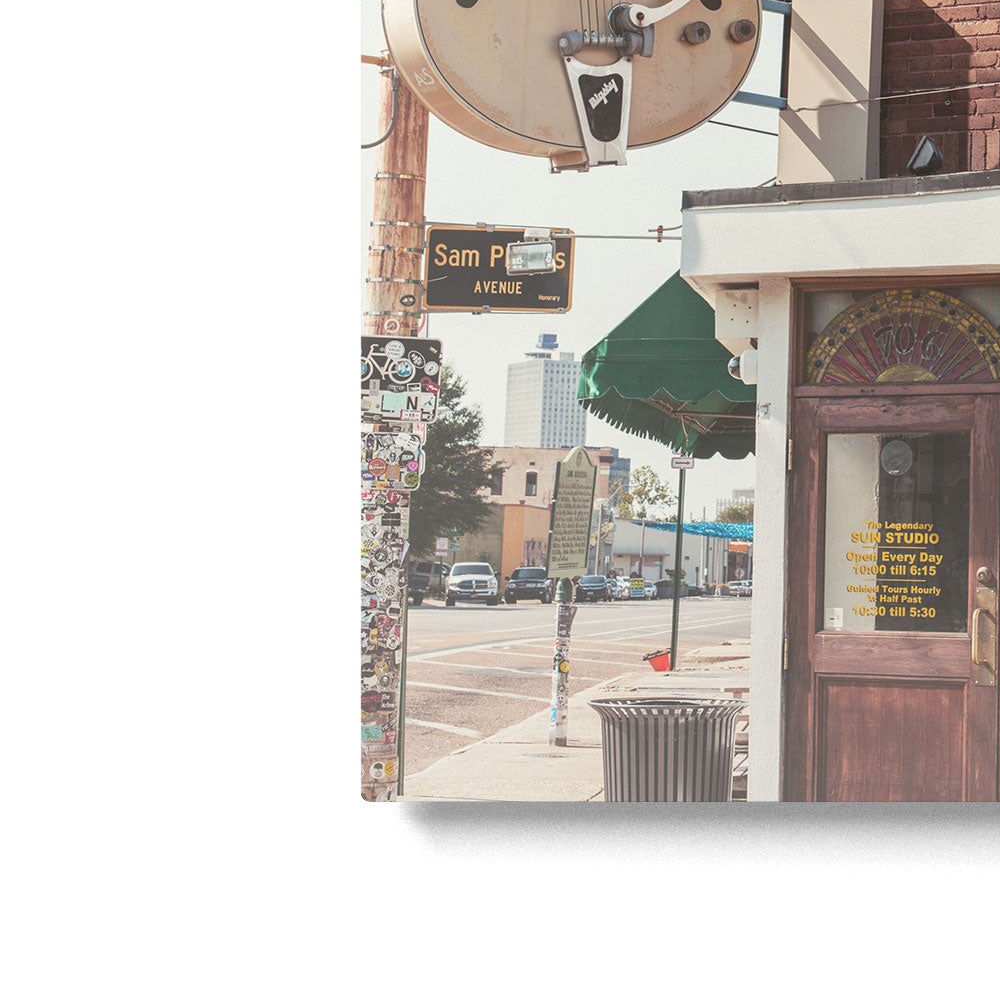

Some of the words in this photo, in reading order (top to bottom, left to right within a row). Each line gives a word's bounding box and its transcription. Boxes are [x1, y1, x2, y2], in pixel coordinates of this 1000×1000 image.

[433, 243, 480, 268] Sam
[473, 280, 523, 295] AVENUE
[538, 294, 561, 302] Honorary
[873, 323, 947, 361] 706
[865, 520, 883, 530] The
[884, 521, 934, 532] Legendary
[851, 531, 881, 544] SUN
[885, 532, 940, 545] STUDIO
[846, 551, 878, 563] Open
[881, 551, 916, 564] Every
[919, 552, 943, 565] Day
[853, 564, 887, 575] 10:00
[890, 565, 907, 576] till
[910, 565, 937, 576] 6:15
[847, 584, 880, 593] Guided
[881, 585, 908, 594] Tours
[911, 585, 941, 596] Hourly
[880, 595, 899, 603] Half
[901, 595, 922, 604] Past
[852, 606, 886, 617] 10:30
[889, 606, 906, 617] till
[909, 607, 936, 618] 5:30
